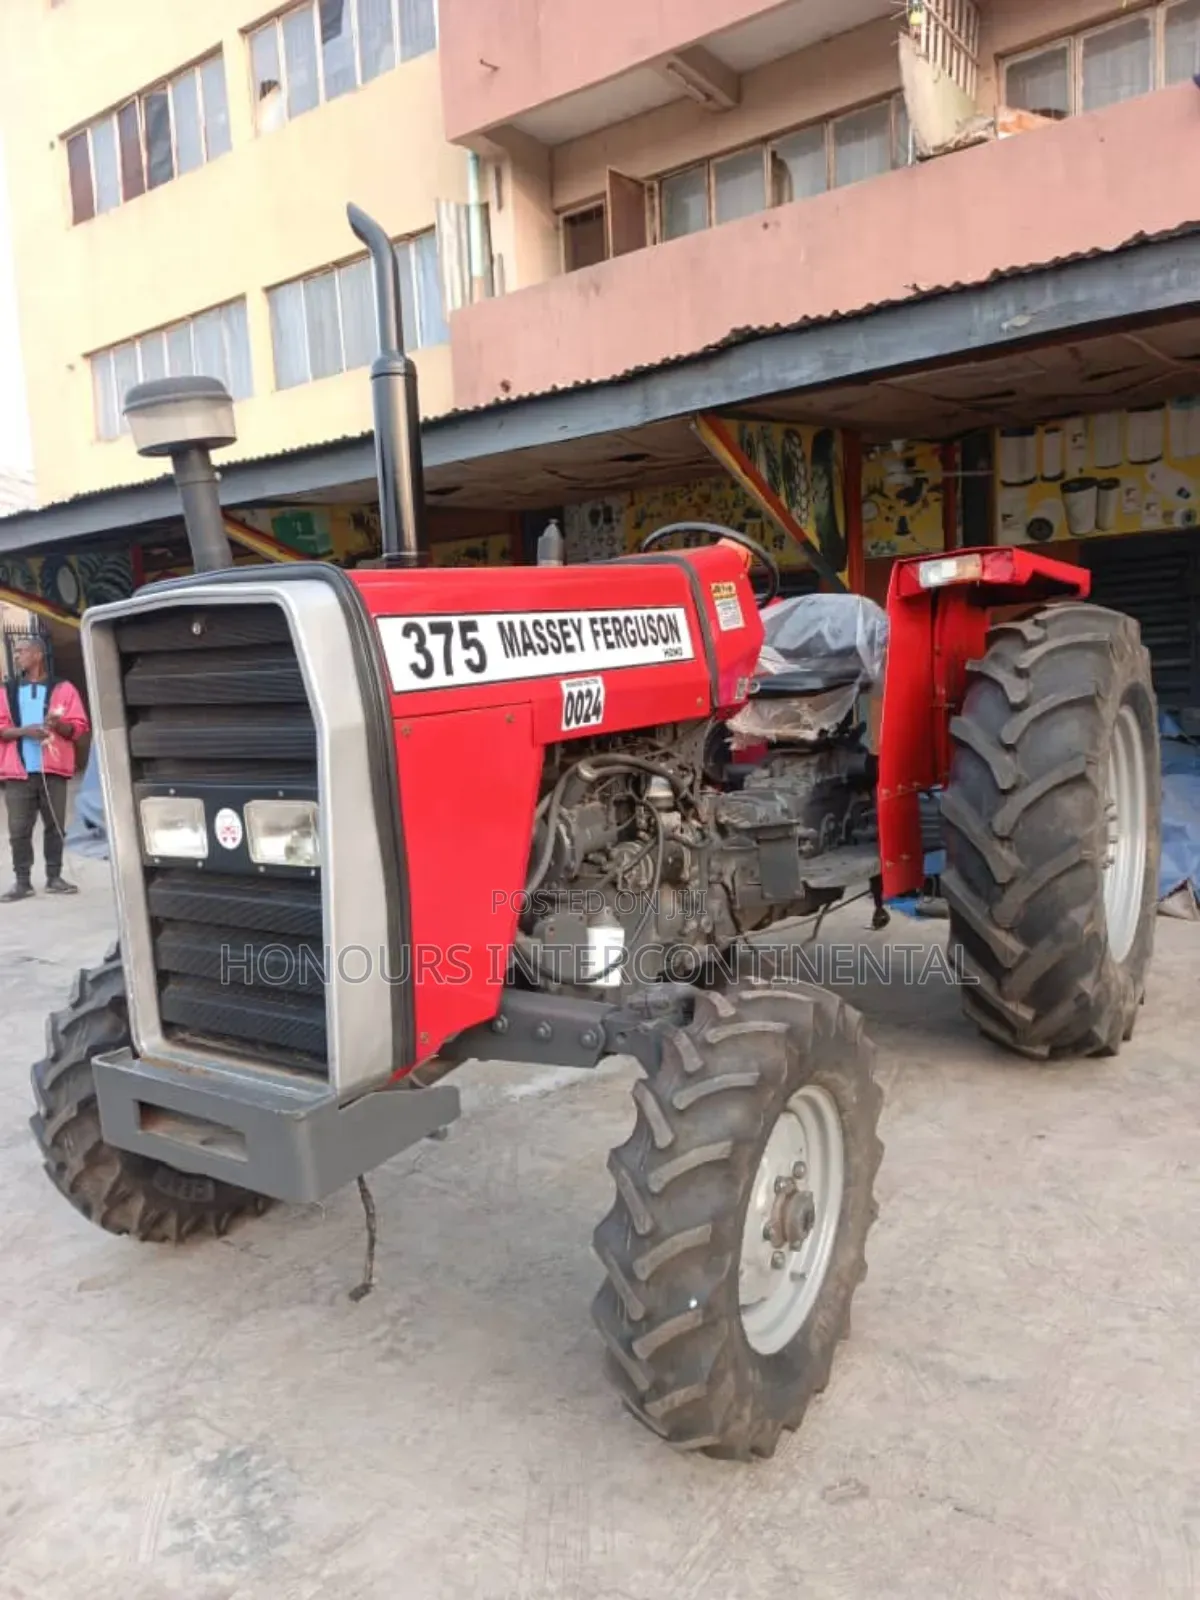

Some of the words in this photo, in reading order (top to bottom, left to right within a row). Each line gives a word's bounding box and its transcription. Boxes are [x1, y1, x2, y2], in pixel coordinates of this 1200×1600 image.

[401, 620, 487, 679] 375
[497, 618, 585, 659] MASSEY
[588, 613, 682, 651] FERGUSON
[564, 685, 602, 728] 0024
